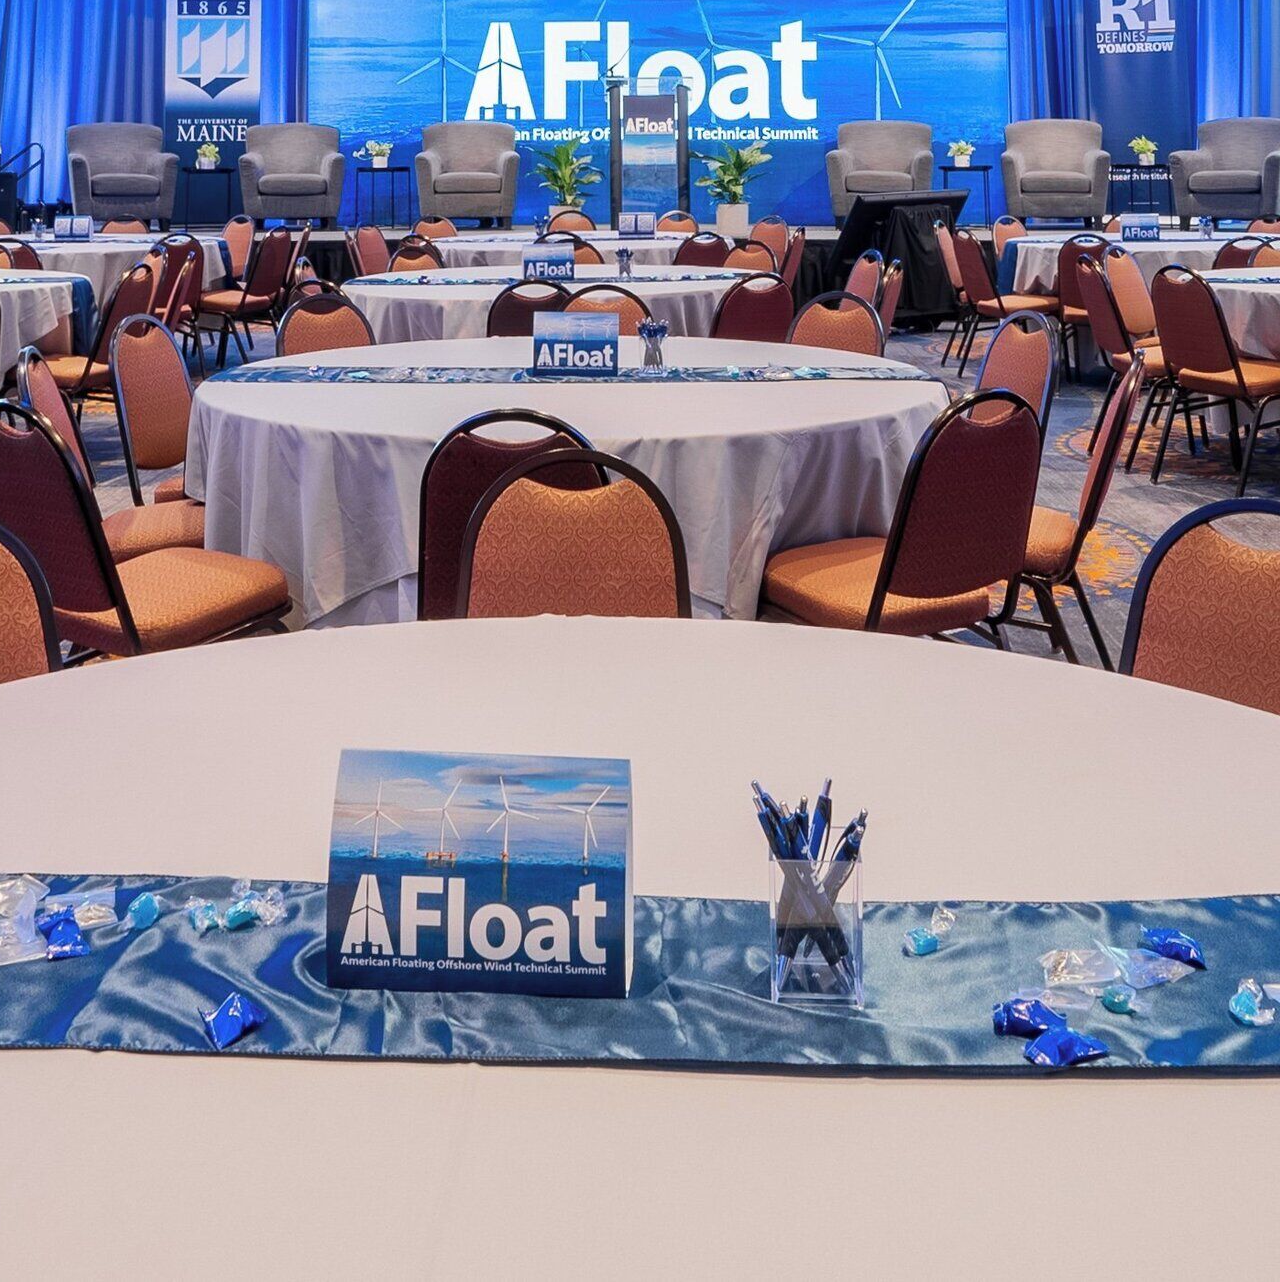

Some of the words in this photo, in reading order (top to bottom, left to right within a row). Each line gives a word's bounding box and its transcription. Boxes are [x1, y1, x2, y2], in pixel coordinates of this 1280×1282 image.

[1096, 31, 1146, 44] DEFINES
[1097, 41, 1174, 54] TOMORROW
[464, 20, 818, 121] AFloat
[176, 125, 247, 142] MAINE
[625, 117, 674, 134] AFloat
[695, 127, 760, 141] Technical
[763, 127, 819, 141] Summit
[1124, 227, 1159, 238] AFloat
[526, 261, 573, 277] AFloat
[537, 343, 614, 368] AFloat
[340, 873, 608, 965] AFloat
[340, 955, 391, 967] American
[392, 957, 435, 971] Floating
[436, 959, 483, 971] Offshore
[484, 960, 512, 973] Wind
[514, 962, 564, 975] Technical
[565, 964, 607, 976] Summit
